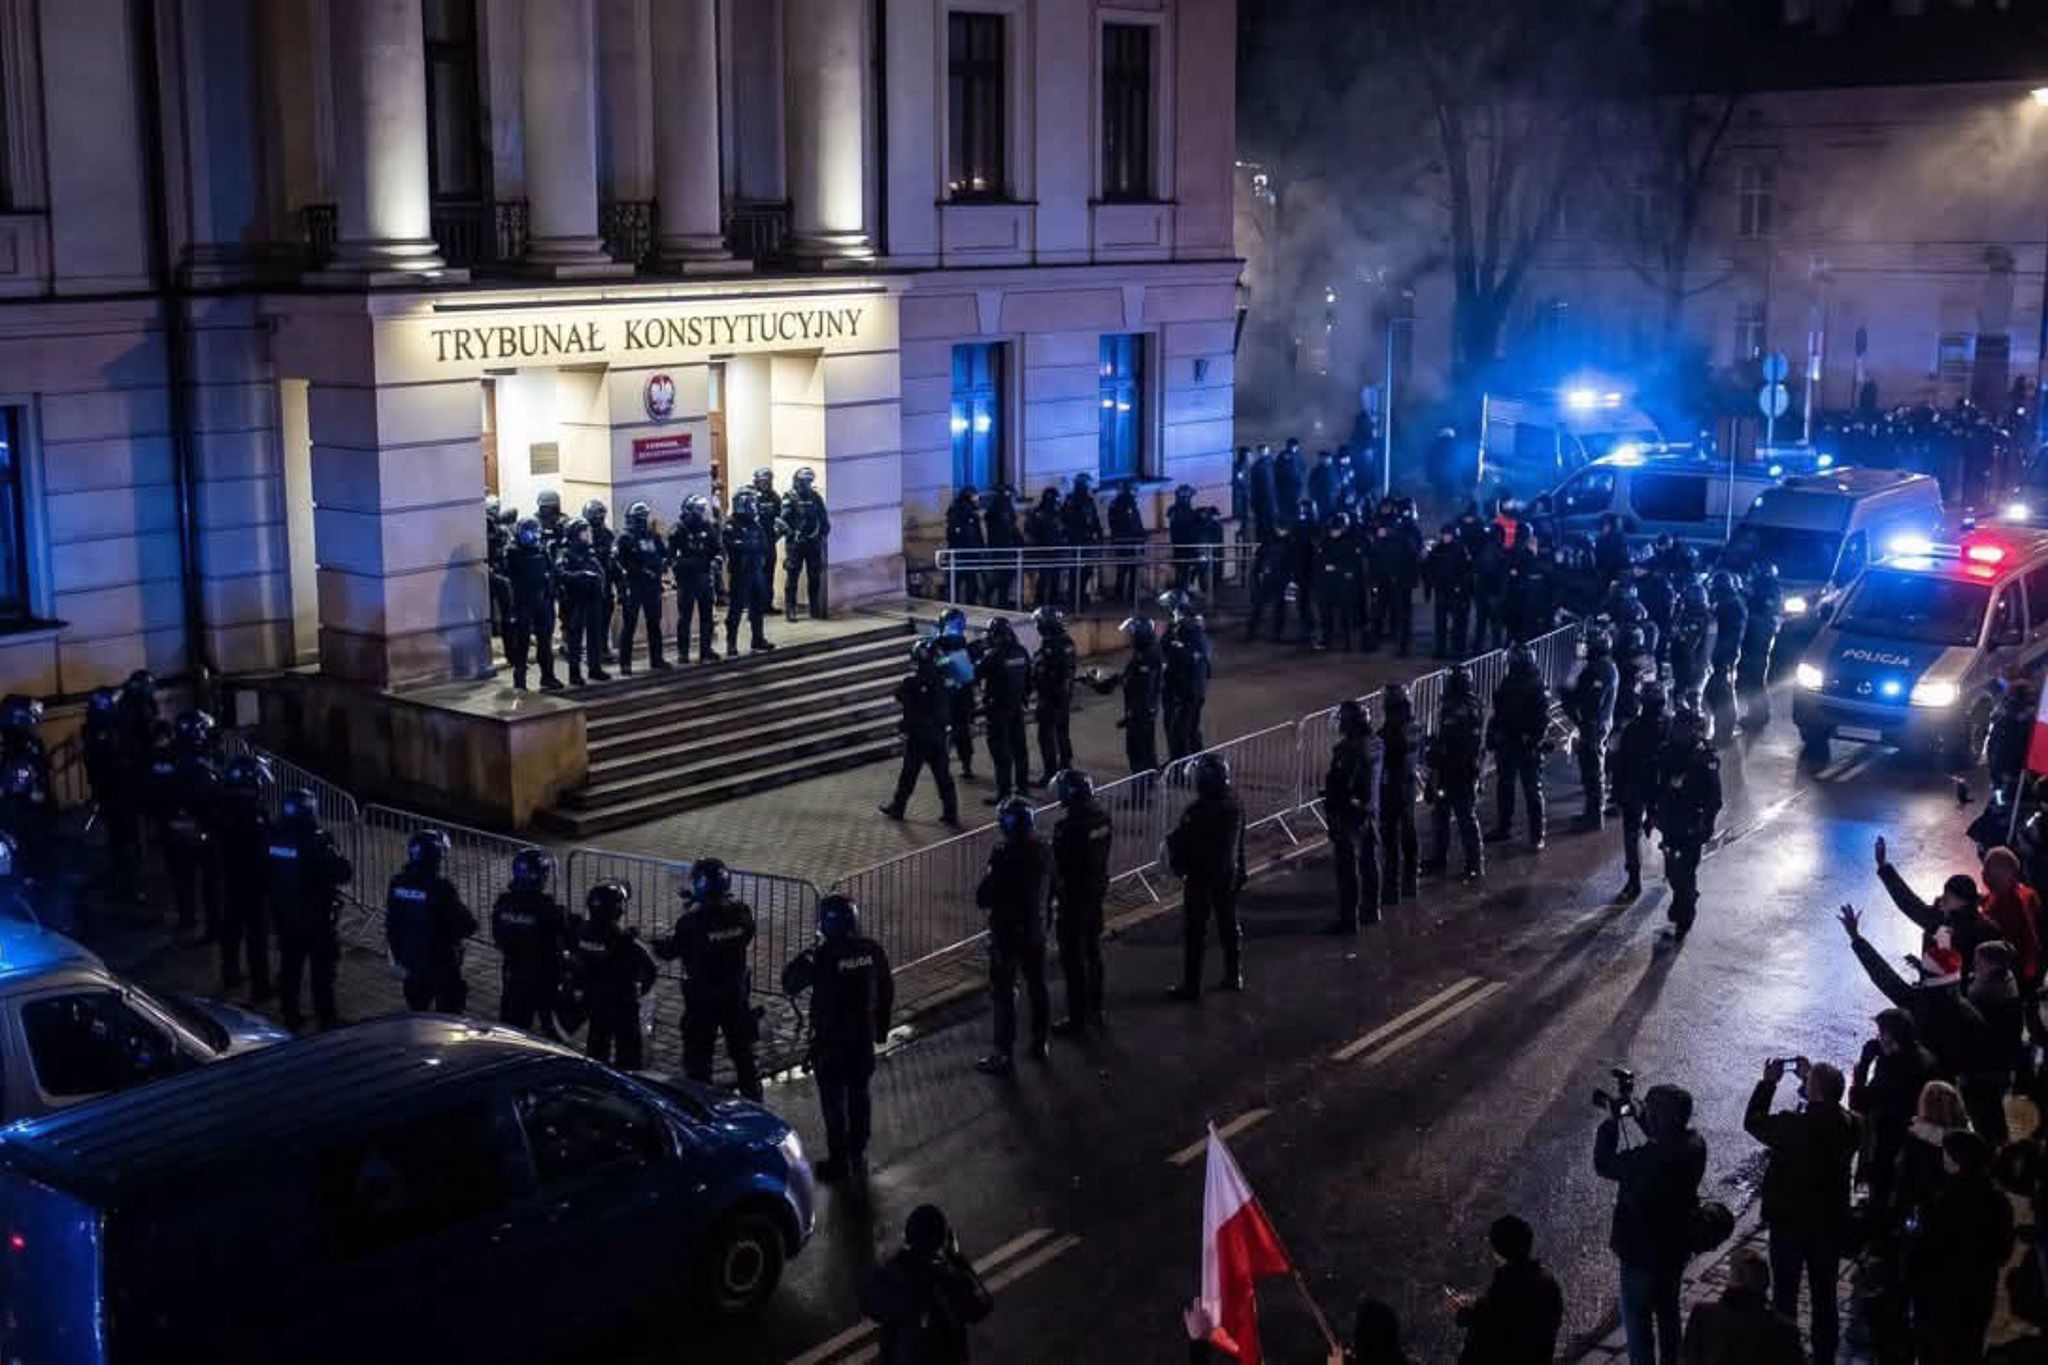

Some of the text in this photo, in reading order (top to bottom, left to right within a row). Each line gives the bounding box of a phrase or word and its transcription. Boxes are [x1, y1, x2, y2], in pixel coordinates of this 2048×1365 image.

[431, 308, 863, 362] TRYBUNAŁ KONSTYTUCYJNY
[1842, 648, 1910, 667] POLICJA
